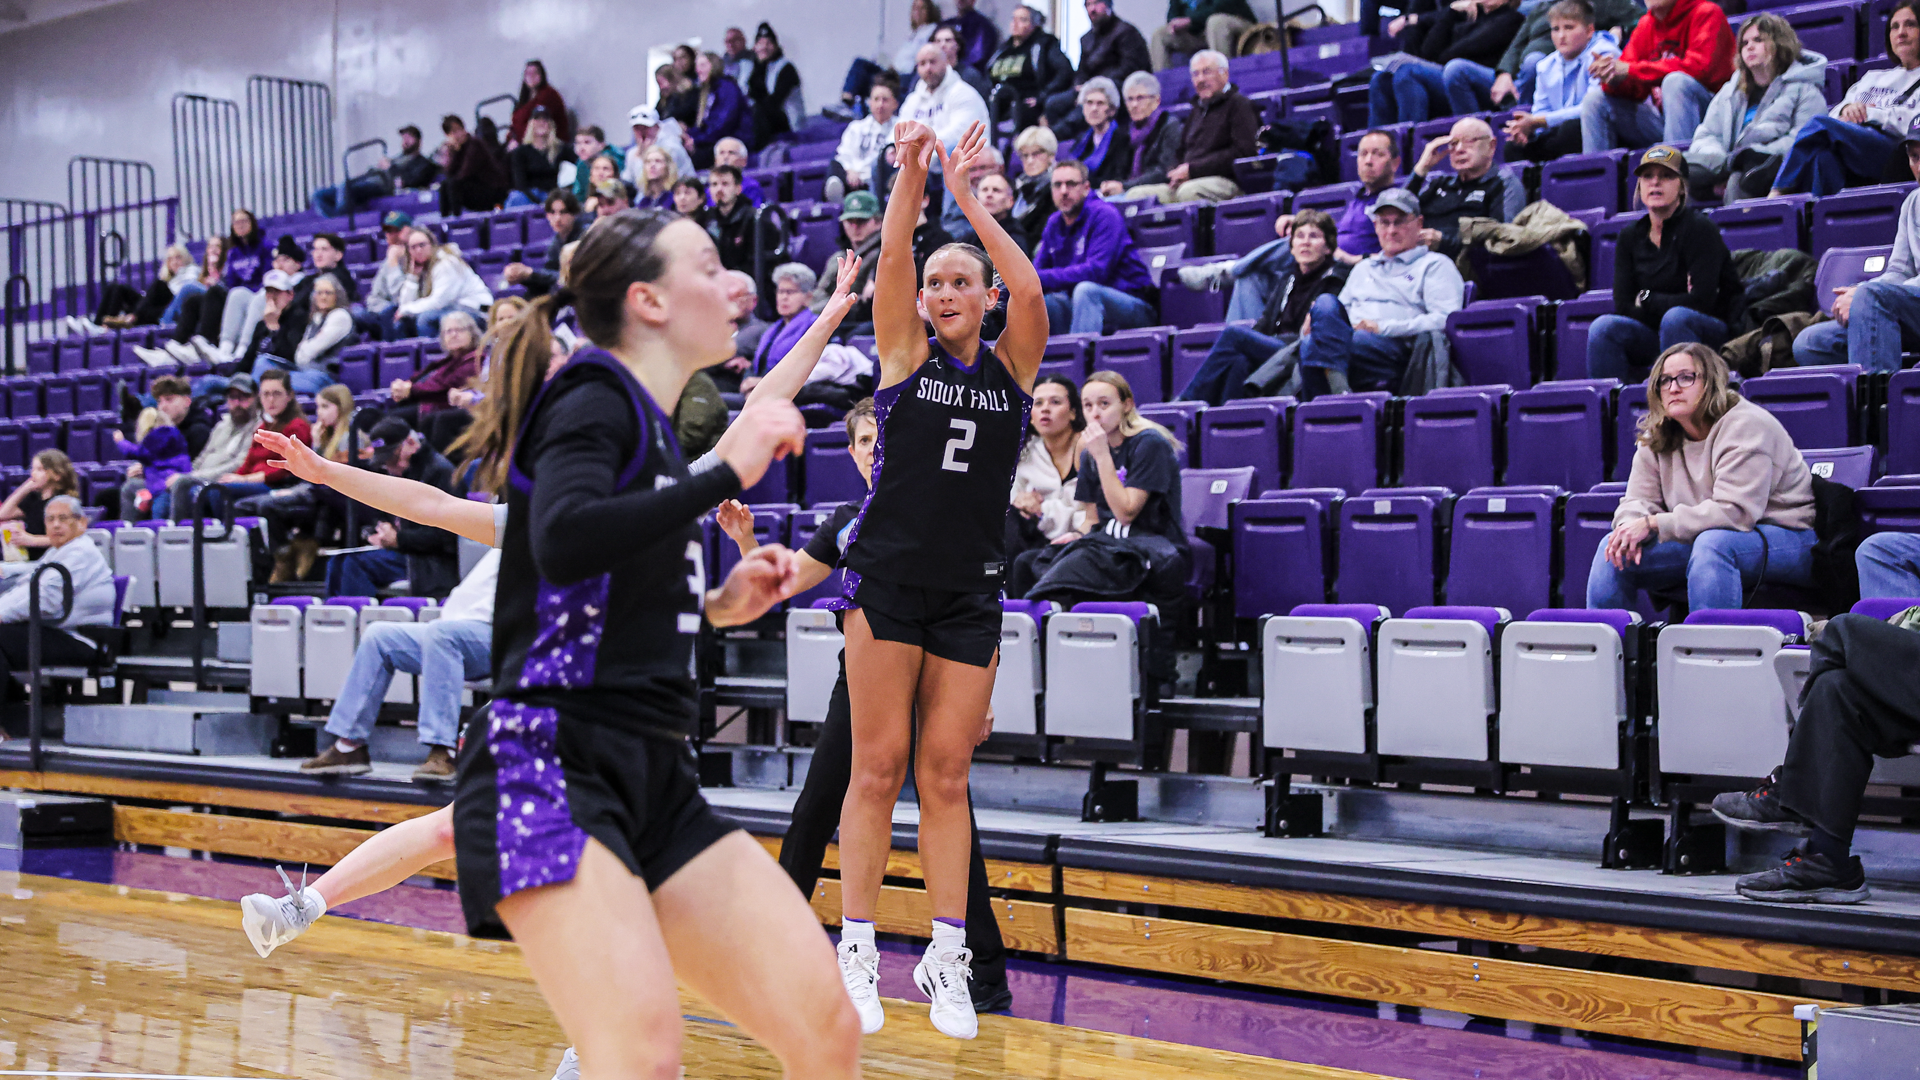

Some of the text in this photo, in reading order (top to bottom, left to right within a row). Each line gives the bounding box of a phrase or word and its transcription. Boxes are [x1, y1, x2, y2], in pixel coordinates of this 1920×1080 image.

[917, 377, 1009, 411] SIOUX FALLS
[941, 418, 977, 473] 2
[1815, 464, 1829, 476] 35
